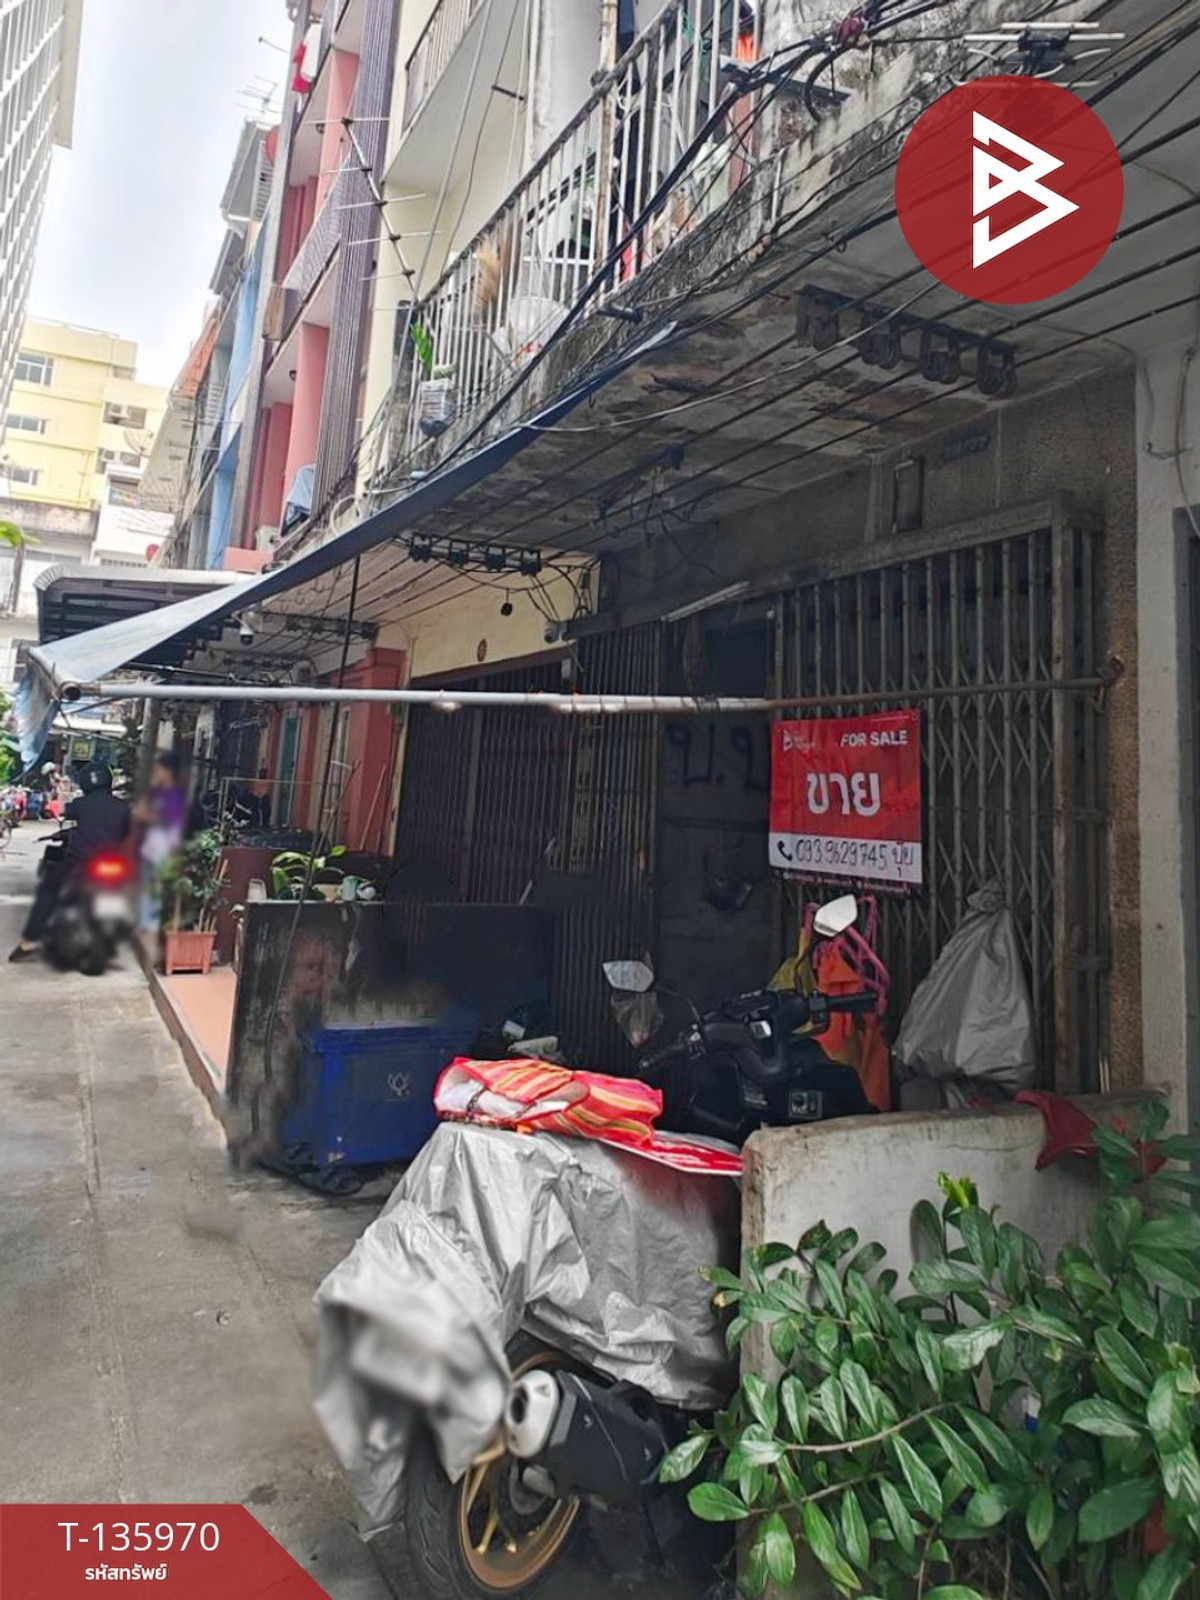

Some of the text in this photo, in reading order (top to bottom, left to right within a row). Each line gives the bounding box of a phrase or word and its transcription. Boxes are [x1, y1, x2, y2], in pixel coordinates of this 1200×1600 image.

[840, 730, 908, 748] FOR SALE
[806, 771, 881, 817] ขาย
